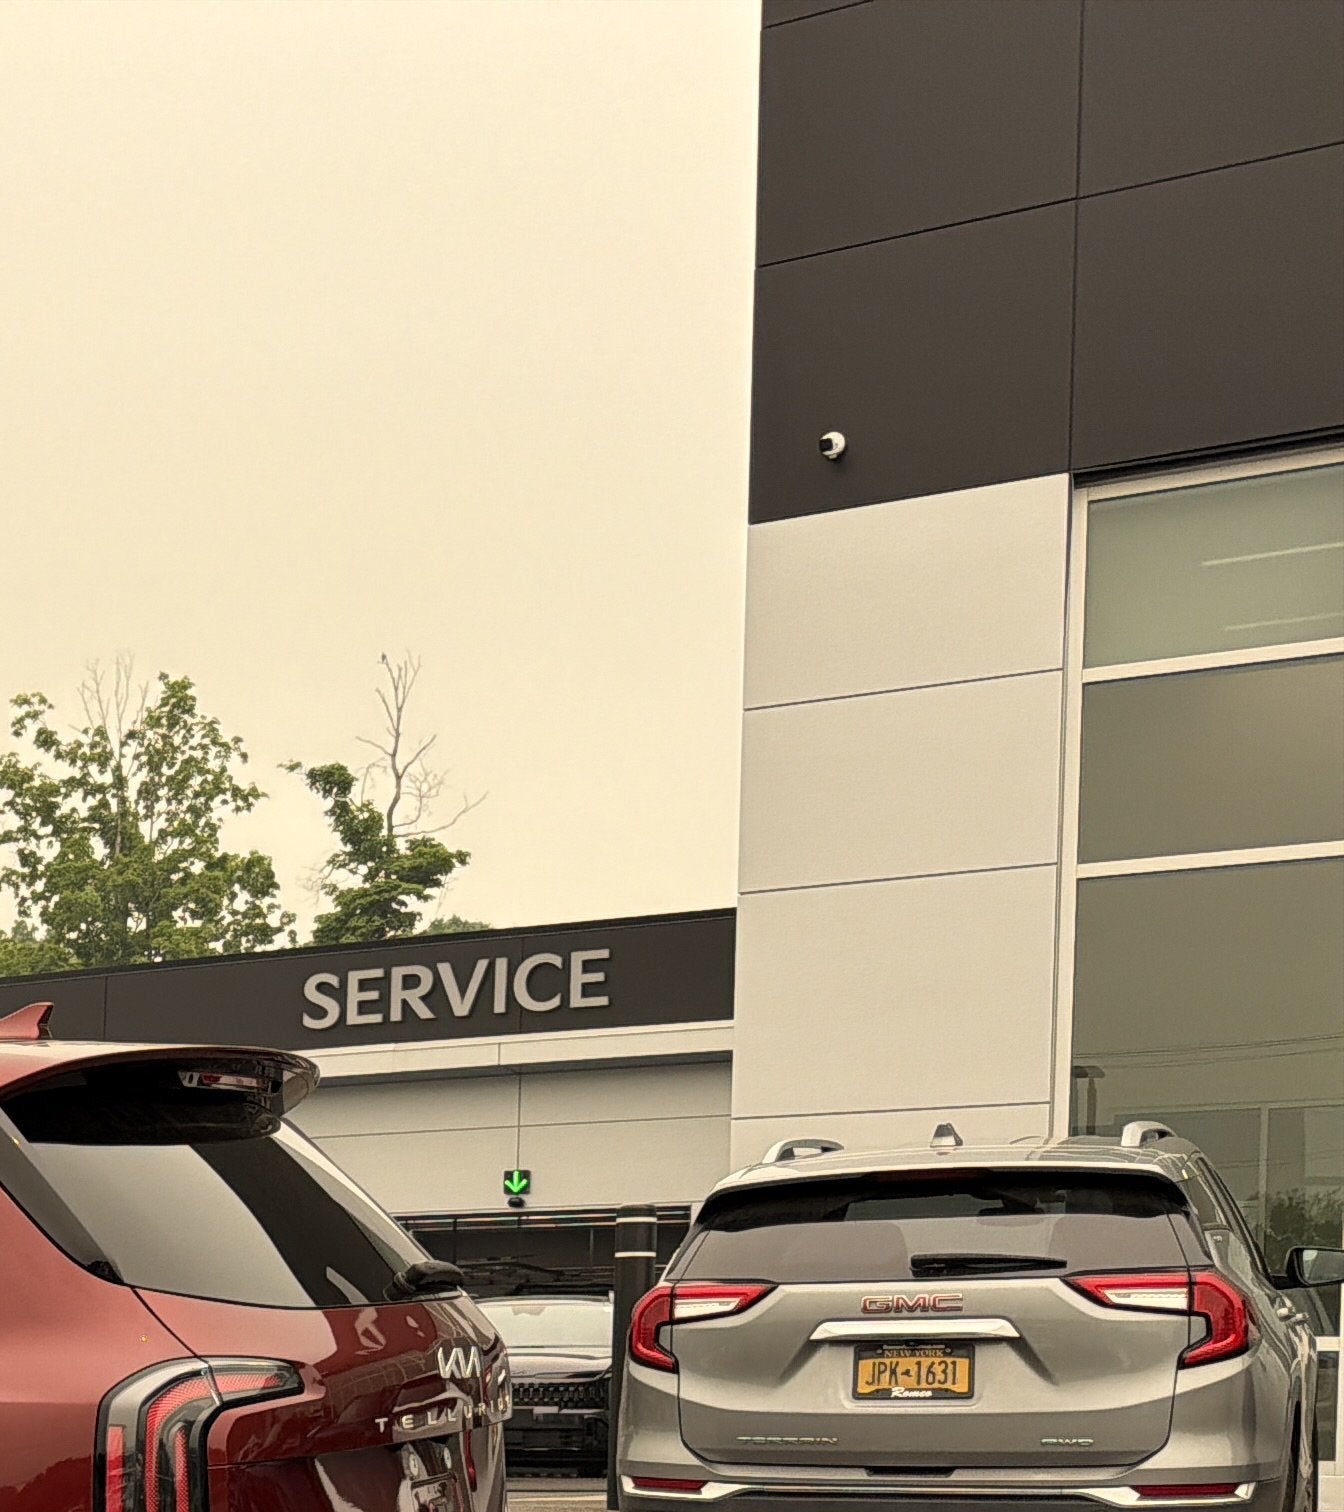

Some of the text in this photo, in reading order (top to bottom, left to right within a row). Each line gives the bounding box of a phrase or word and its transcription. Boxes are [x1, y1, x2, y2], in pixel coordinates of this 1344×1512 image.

[302, 948, 611, 1030] SERVICE
[861, 1293, 963, 1314] GMC
[884, 1349, 945, 1358] NEW YORK
